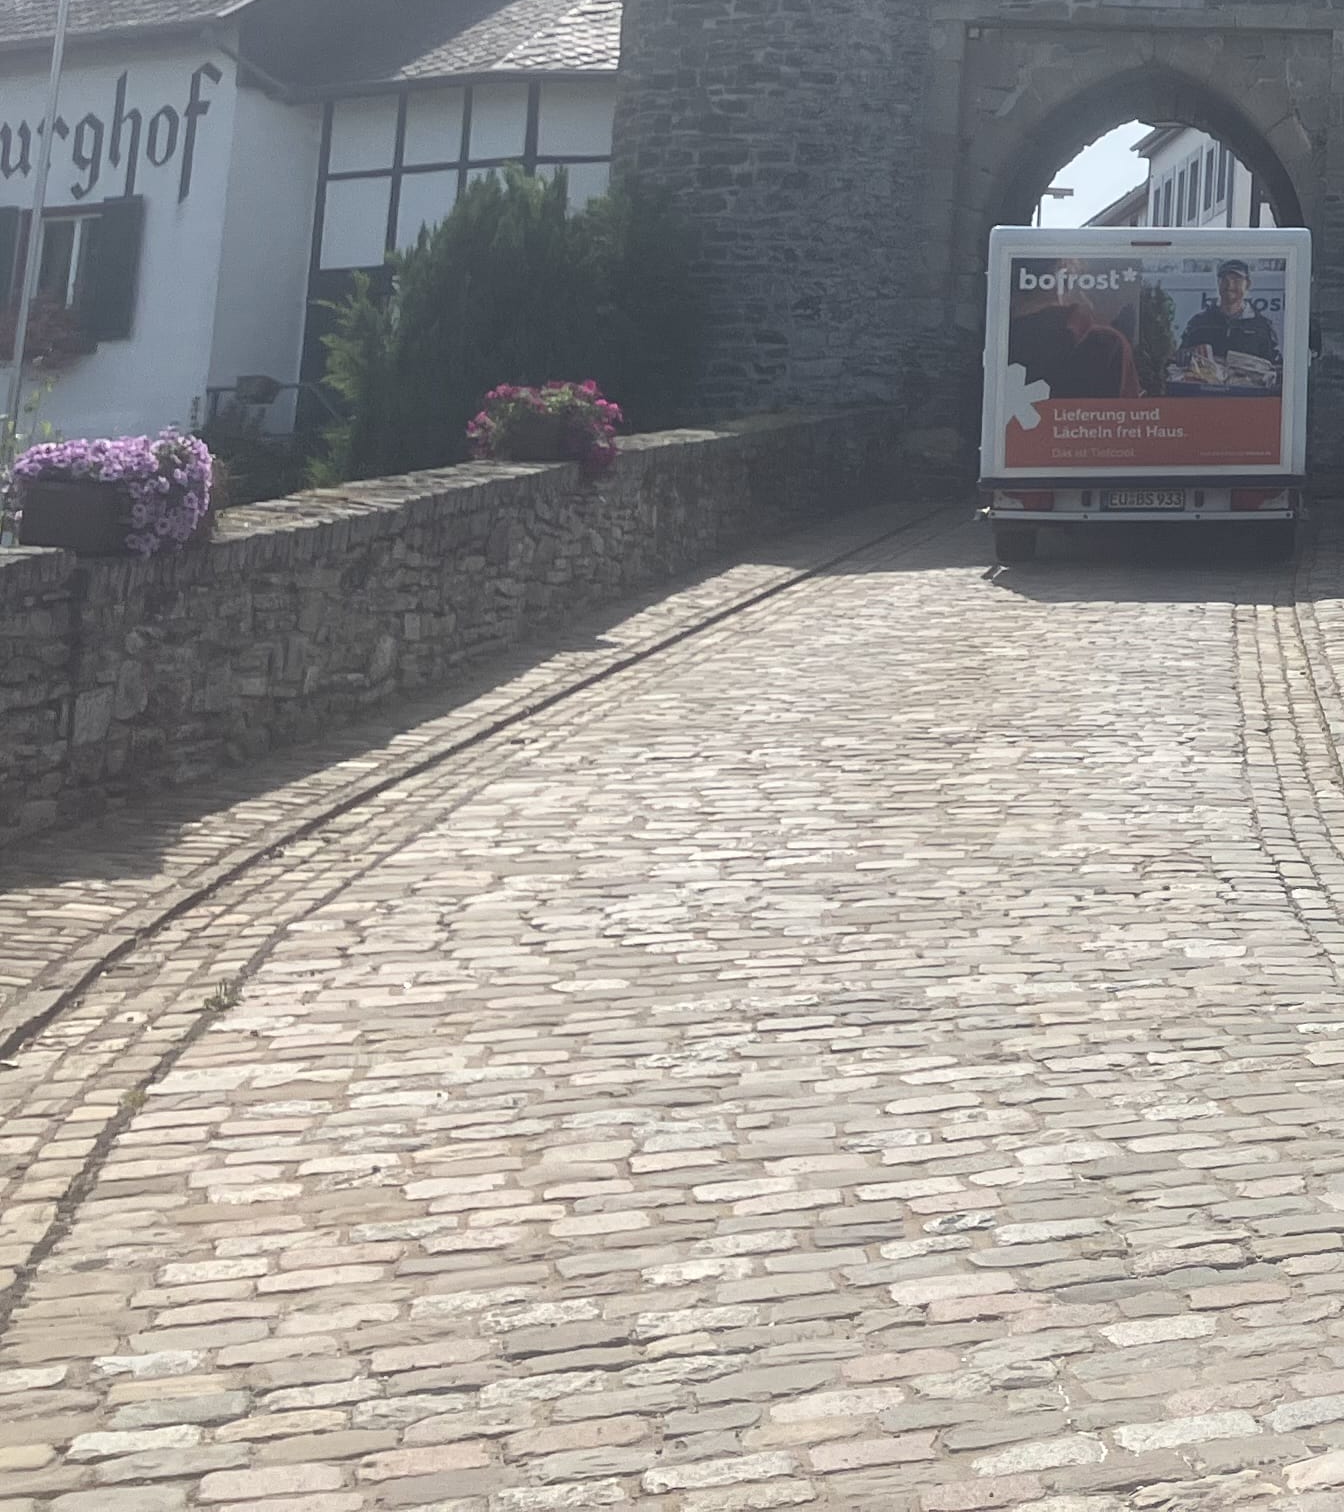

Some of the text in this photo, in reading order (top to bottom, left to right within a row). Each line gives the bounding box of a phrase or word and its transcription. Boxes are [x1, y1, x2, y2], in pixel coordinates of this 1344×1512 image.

[1053, 408, 1160, 424] Lieferung und
[1053, 425, 1113, 439] Lächeln
[1116, 425, 1141, 439] frei
[1110, 492, 1128, 506] EU
[1157, 492, 1182, 506] 933
